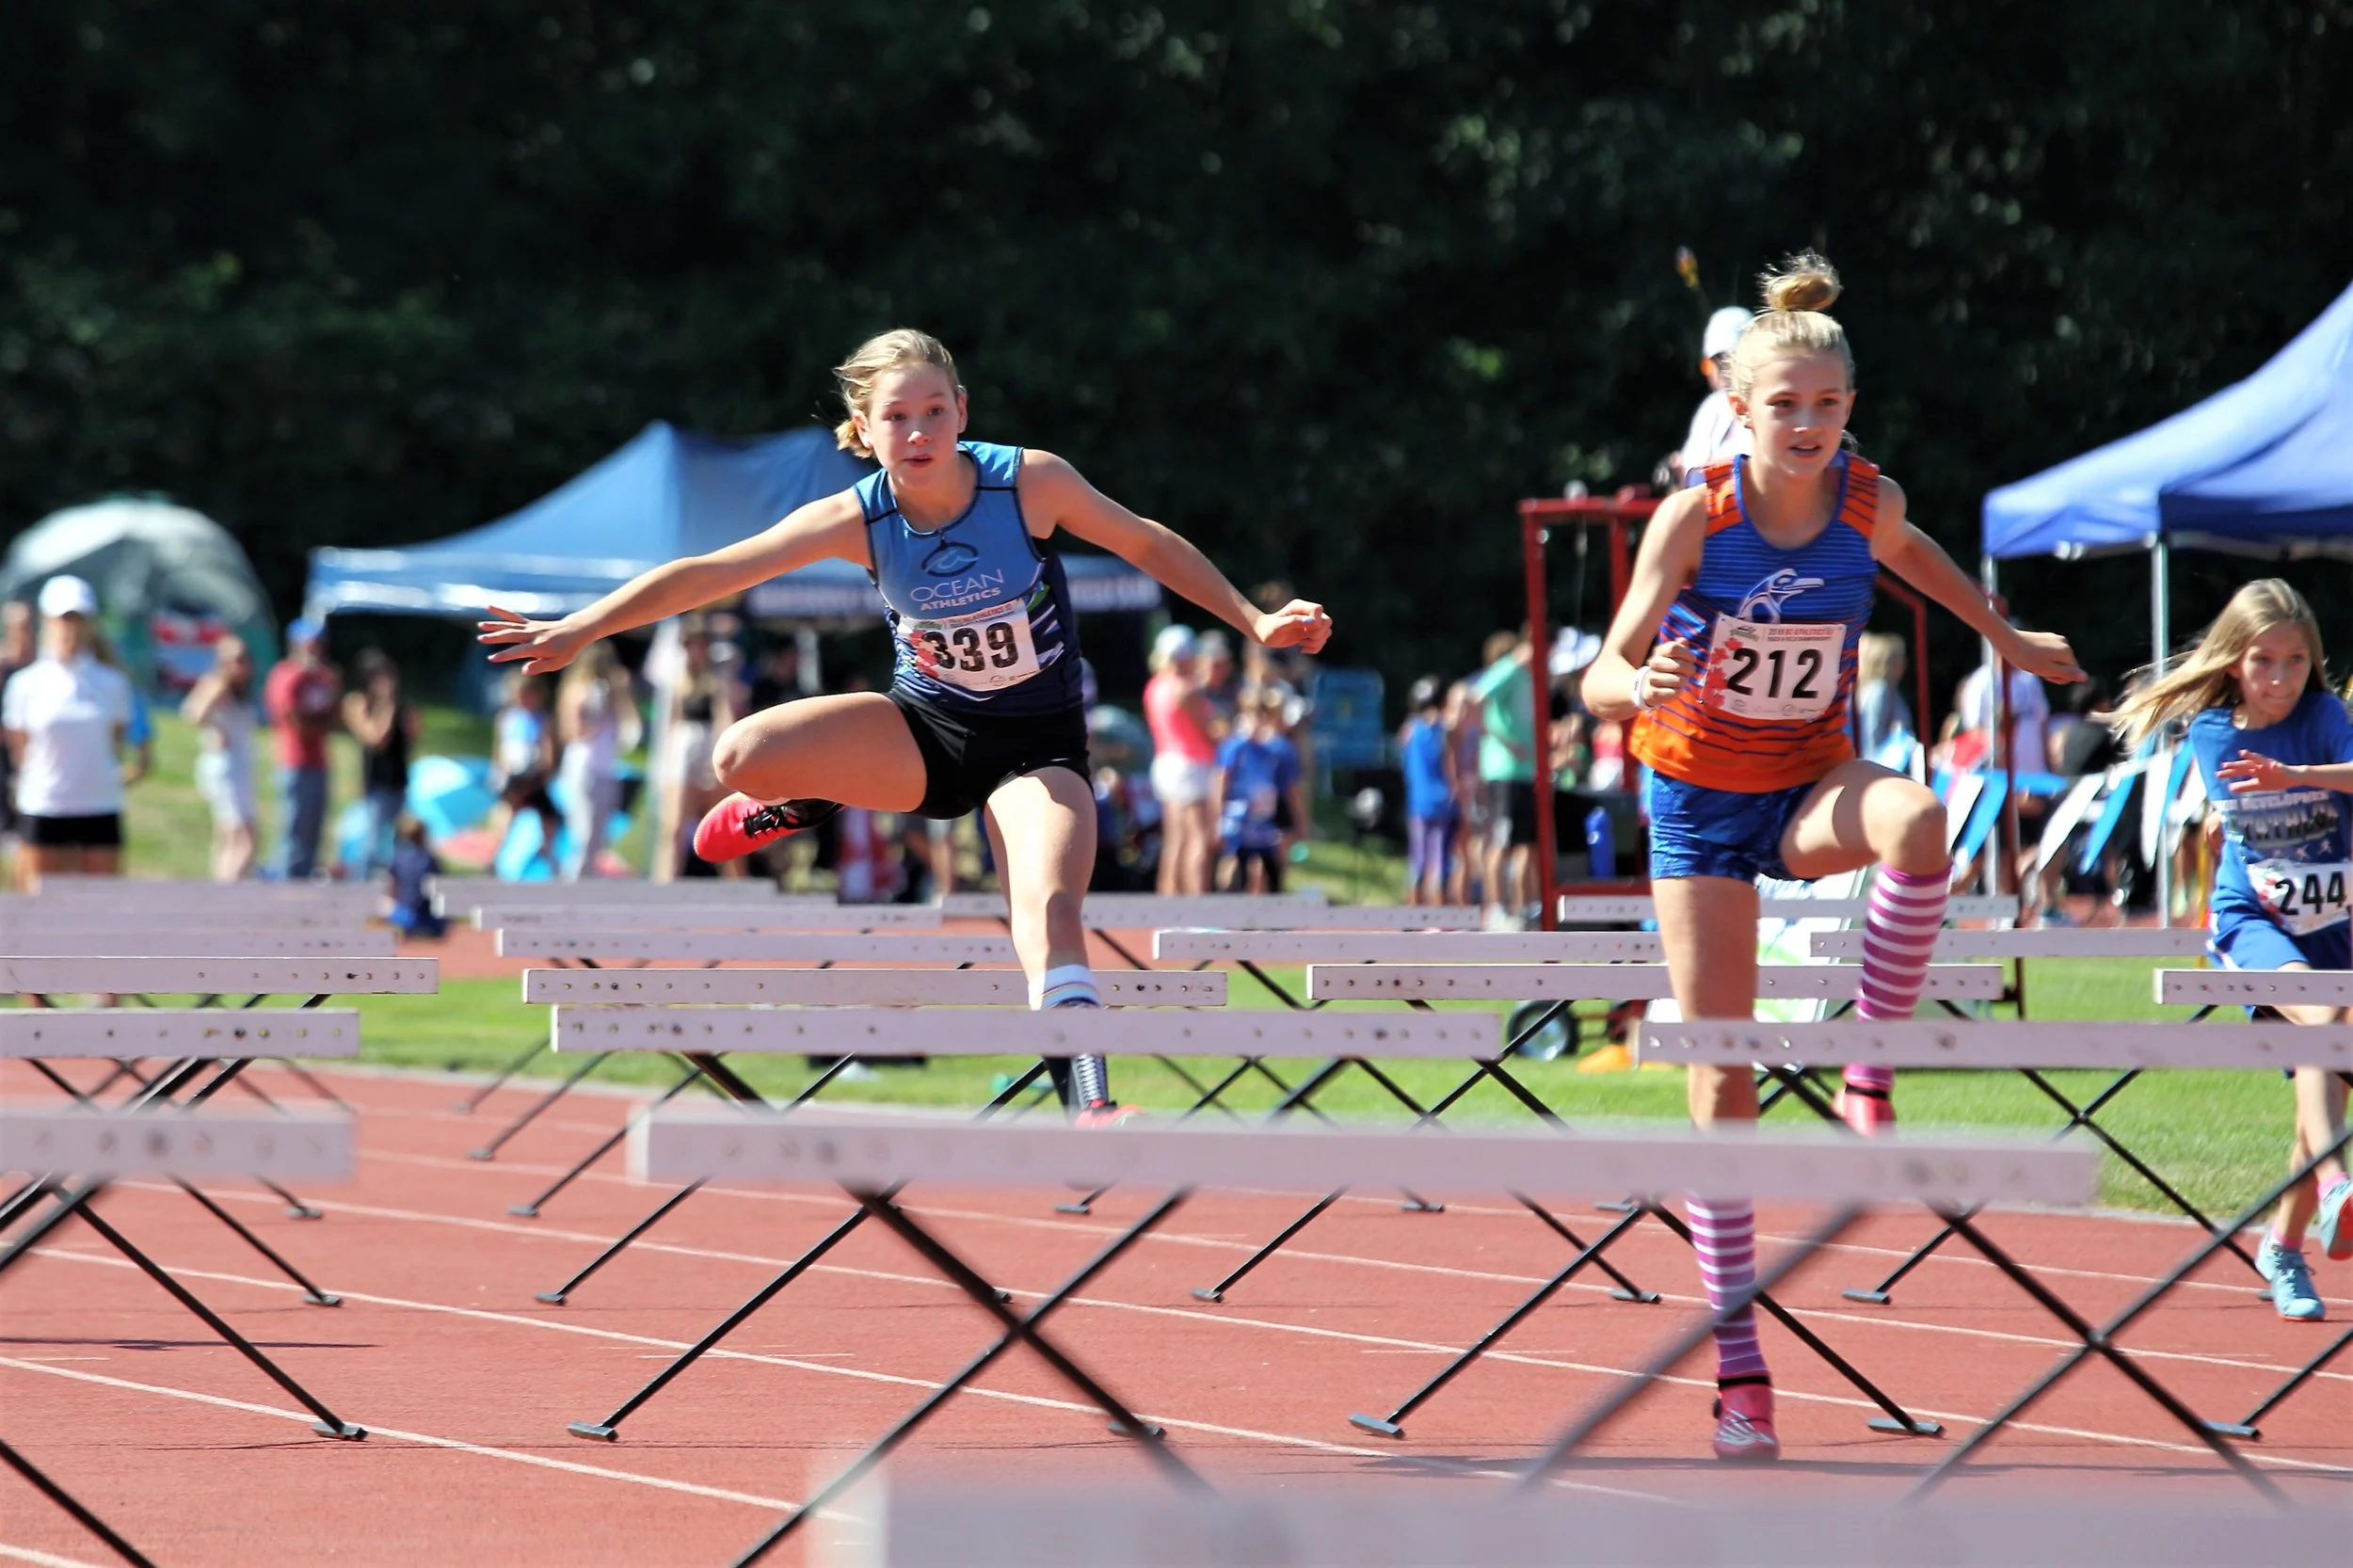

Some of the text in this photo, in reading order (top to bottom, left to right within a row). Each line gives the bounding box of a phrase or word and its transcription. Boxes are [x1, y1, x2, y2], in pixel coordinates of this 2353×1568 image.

[909, 568, 1004, 602] OCEAN
[920, 586, 1001, 611] ATHLETICS
[922, 622, 1019, 672] 339
[1727, 648, 1824, 698] 212
[2275, 872, 2346, 916] 244
